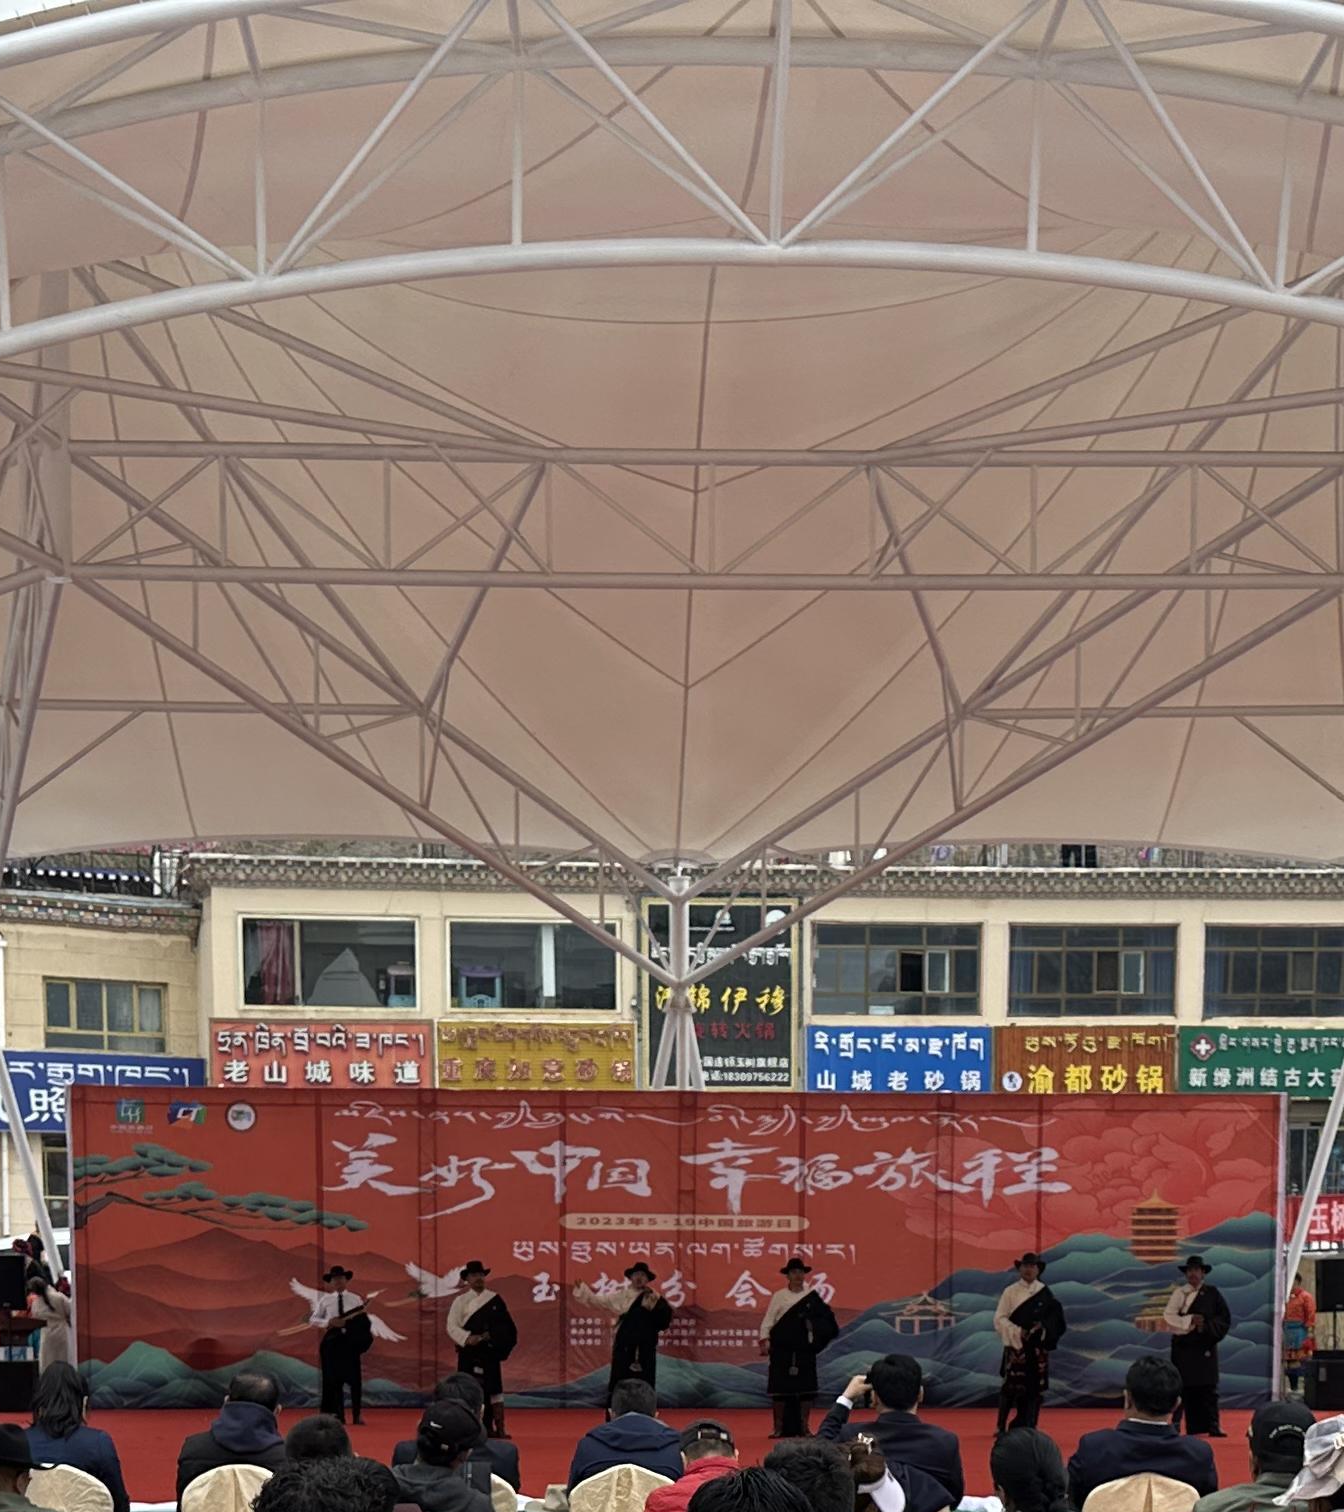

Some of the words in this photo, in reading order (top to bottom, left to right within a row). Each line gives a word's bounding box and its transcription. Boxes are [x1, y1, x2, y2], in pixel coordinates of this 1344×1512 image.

[223, 1059, 421, 1084] 老山城味道
[816, 1069, 982, 1092] 山城老砂锅
[1027, 1064, 1165, 1094] 渝都砂锅
[321, 1132, 653, 1220] 美好中国
[679, 1137, 1073, 1216] 幸福旅程
